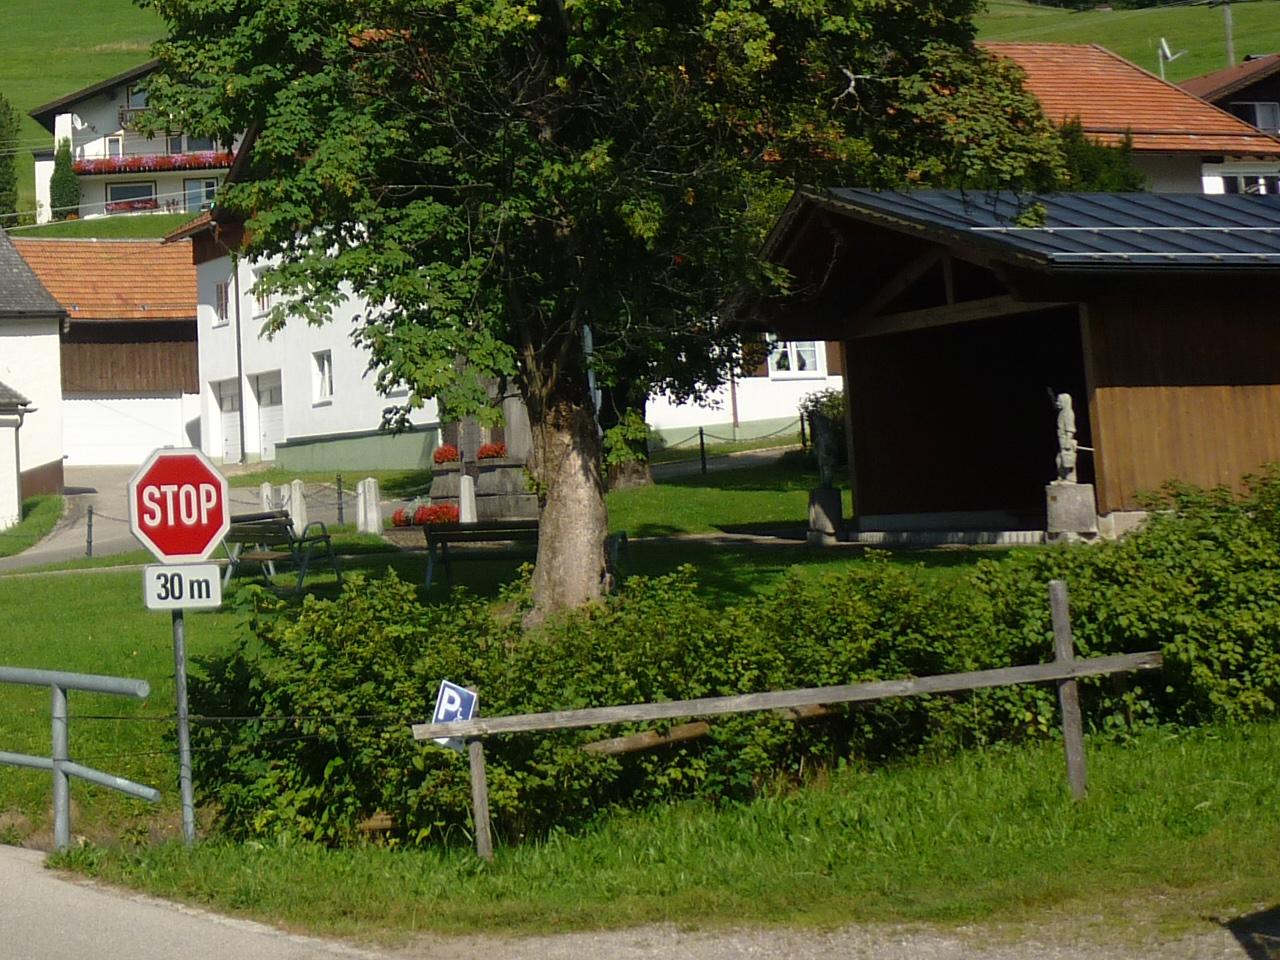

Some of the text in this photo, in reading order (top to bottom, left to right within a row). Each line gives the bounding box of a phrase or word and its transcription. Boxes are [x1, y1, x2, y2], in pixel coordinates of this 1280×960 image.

[142, 483, 217, 527] STOP
[156, 573, 211, 601] 30 m
[438, 686, 461, 720] P
